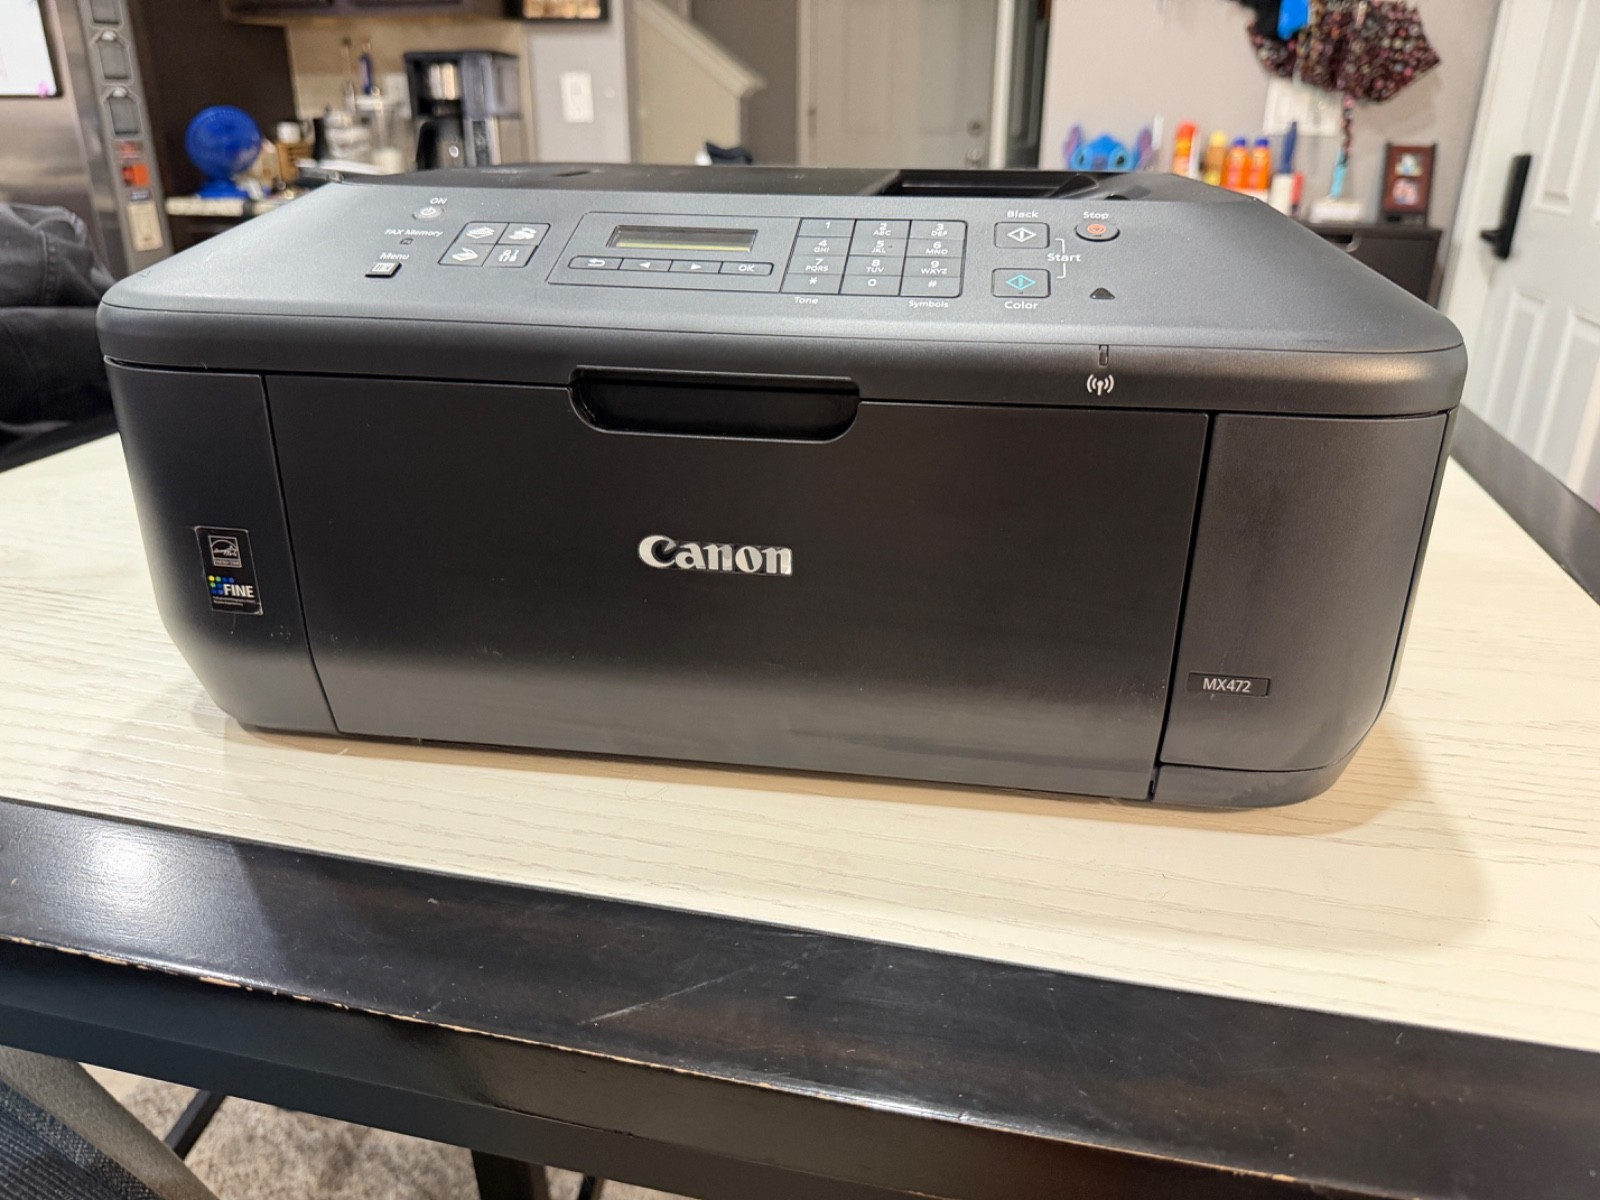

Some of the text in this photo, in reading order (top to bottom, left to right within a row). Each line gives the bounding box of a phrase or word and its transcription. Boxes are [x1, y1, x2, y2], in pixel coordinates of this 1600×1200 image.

[429, 197, 447, 205] ON
[1007, 210, 1039, 219] Black
[1083, 211, 1110, 220] Stop
[879, 222, 888, 231] 2
[936, 223, 944, 231] 3
[405, 229, 443, 238] Memory
[818, 239, 827, 247] 4
[876, 240, 885, 248] 5
[933, 241, 942, 249] 6
[380, 252, 409, 260] Menu
[1047, 253, 1082, 262] Start
[815, 258, 824, 266] 7
[871, 259, 880, 267] 8
[930, 260, 940, 268] 9
[738, 263, 756, 273] OK
[794, 296, 819, 305] Tone
[908, 300, 949, 310] Symbols
[1004, 301, 1039, 310] Color
[638, 535, 793, 576] Canon
[223, 583, 255, 598] FINE
[1202, 677, 1252, 693] MX472
